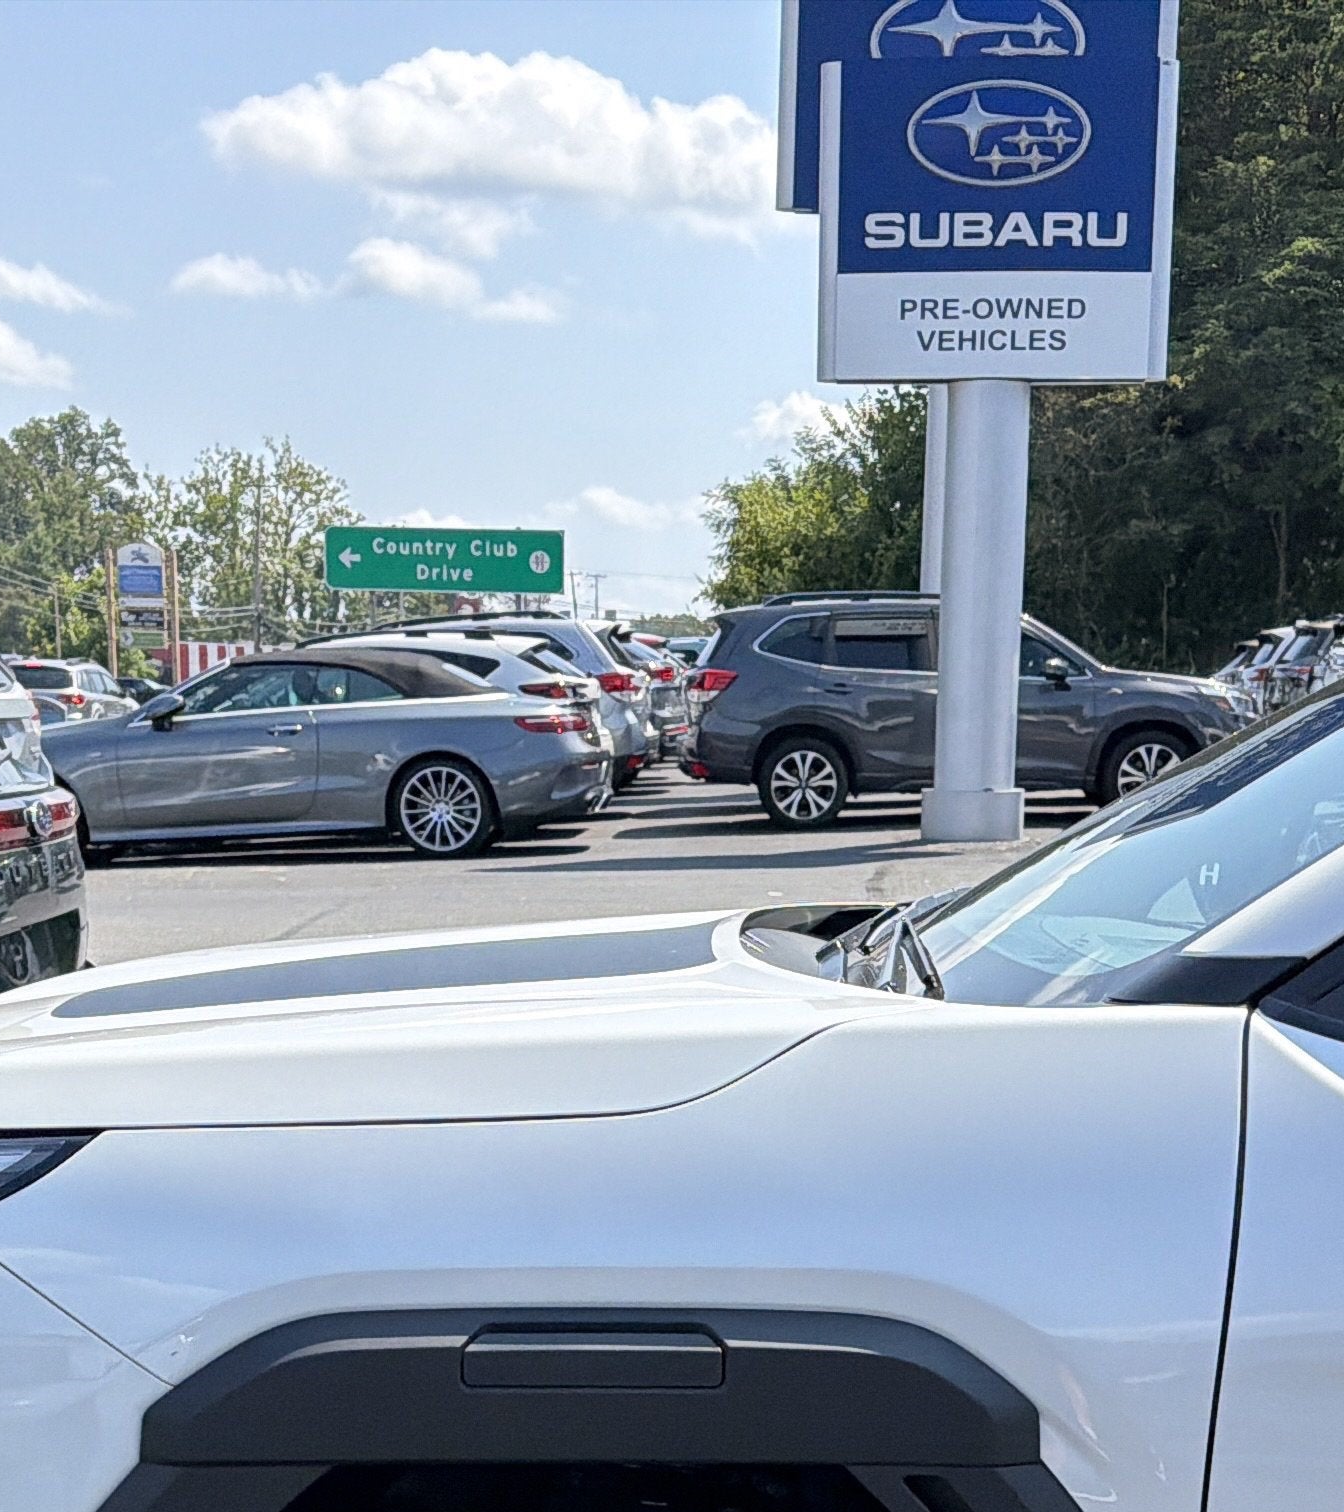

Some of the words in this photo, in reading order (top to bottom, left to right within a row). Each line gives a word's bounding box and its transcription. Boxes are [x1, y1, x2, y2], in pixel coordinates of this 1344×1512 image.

[863, 211, 1129, 250] SUBARU
[899, 298, 1087, 322] PRE-OWNED
[917, 329, 1068, 353] VEHICLES
[372, 537, 458, 560] Country
[470, 540, 519, 558] Club
[416, 564, 474, 582] Drive
[1199, 861, 1221, 887] H
